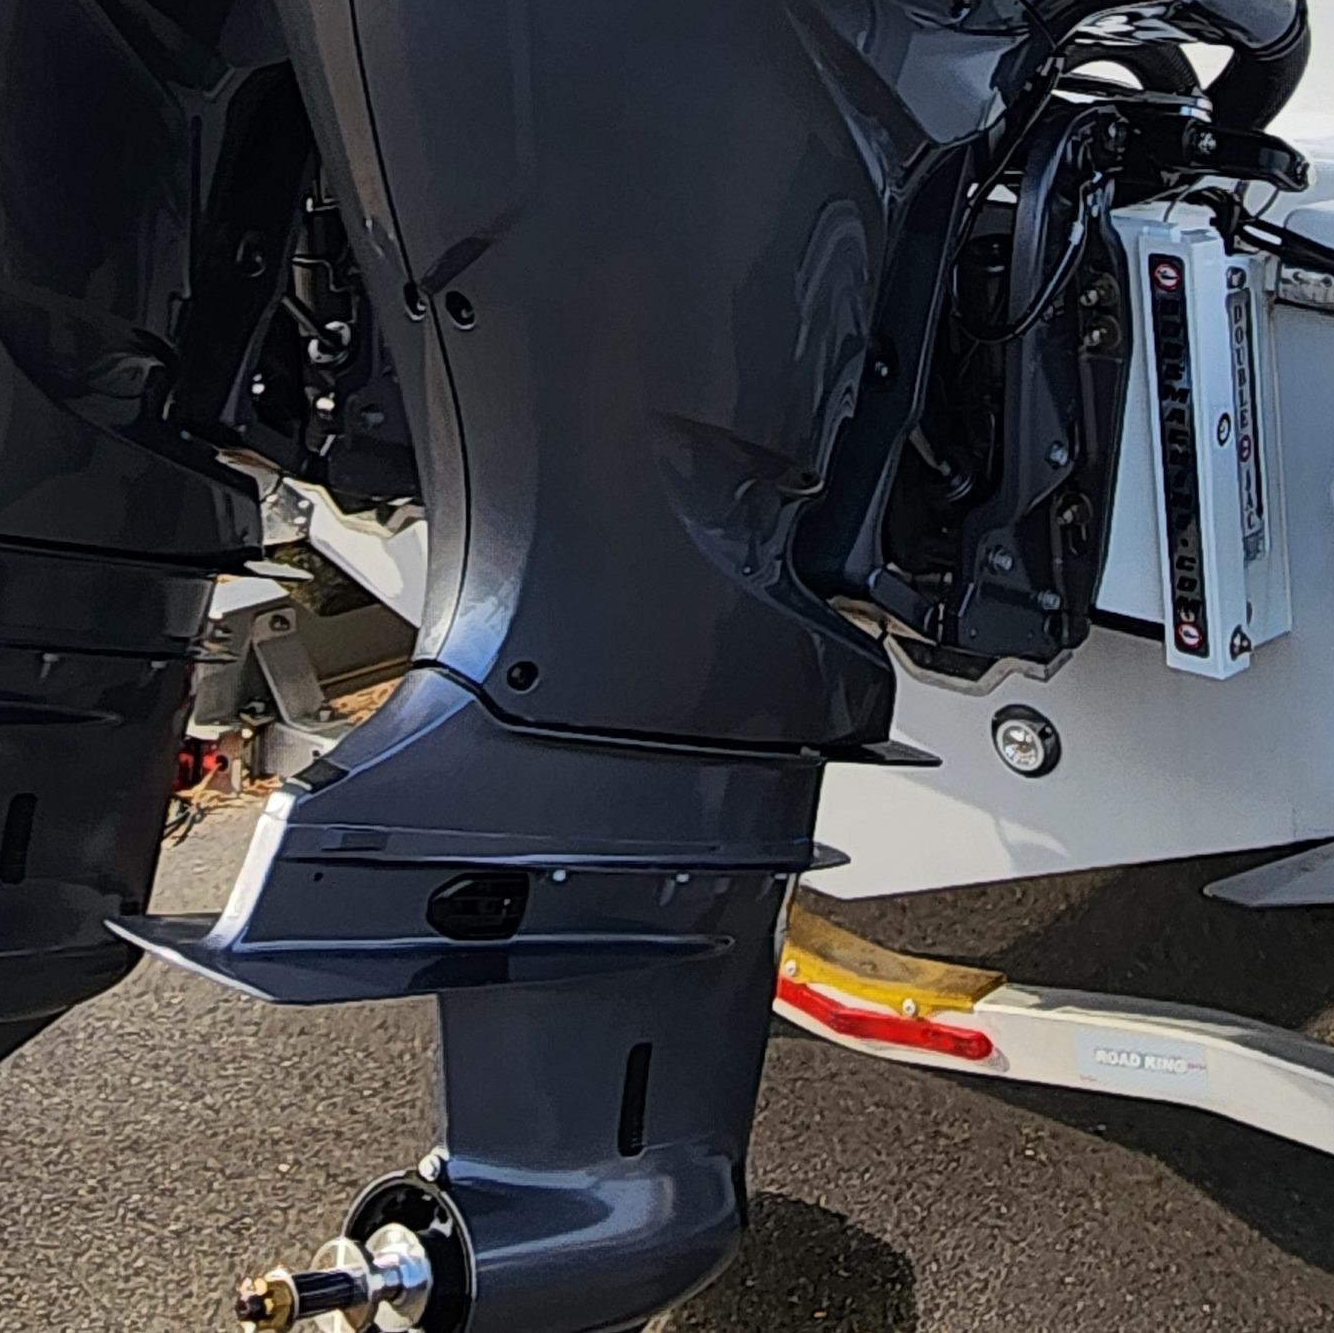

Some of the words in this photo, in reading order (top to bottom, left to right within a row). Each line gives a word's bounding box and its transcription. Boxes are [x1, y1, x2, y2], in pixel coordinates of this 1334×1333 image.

[1233, 303, 1250, 431] DOUBLE
[1094, 1048, 1141, 1069] ROAD
[1143, 1053, 1189, 1075] KING
